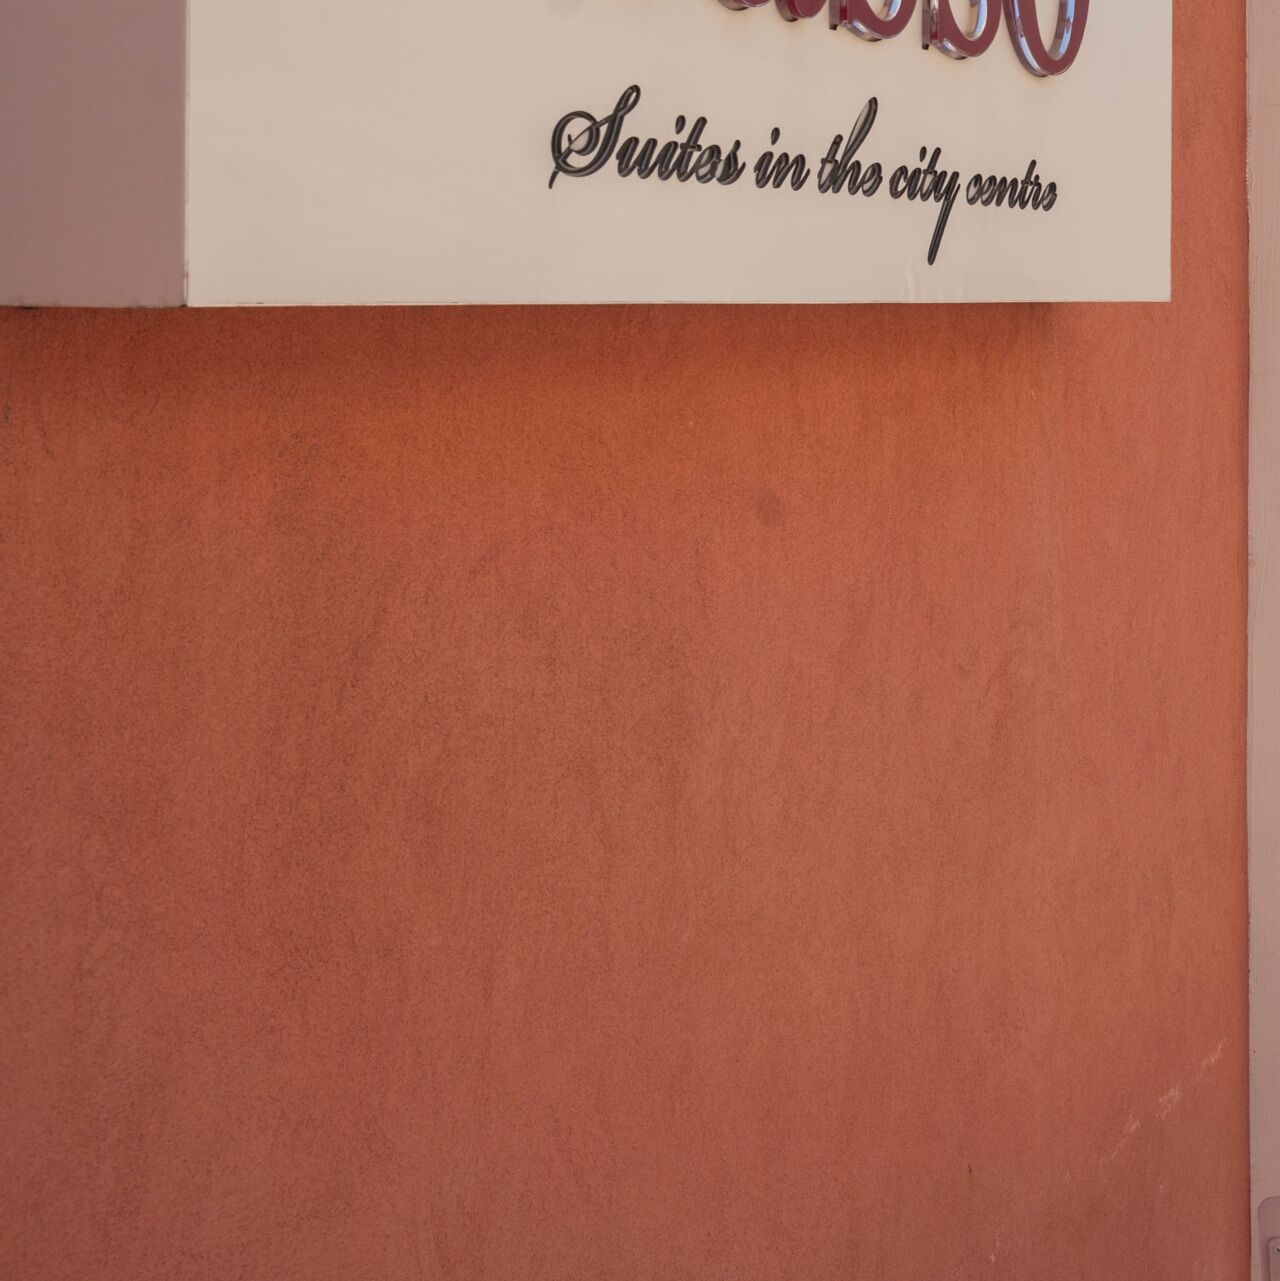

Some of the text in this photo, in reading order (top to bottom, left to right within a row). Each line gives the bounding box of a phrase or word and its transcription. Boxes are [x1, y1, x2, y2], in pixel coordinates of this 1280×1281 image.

[550, 84, 1058, 266] Suites in the city centre
